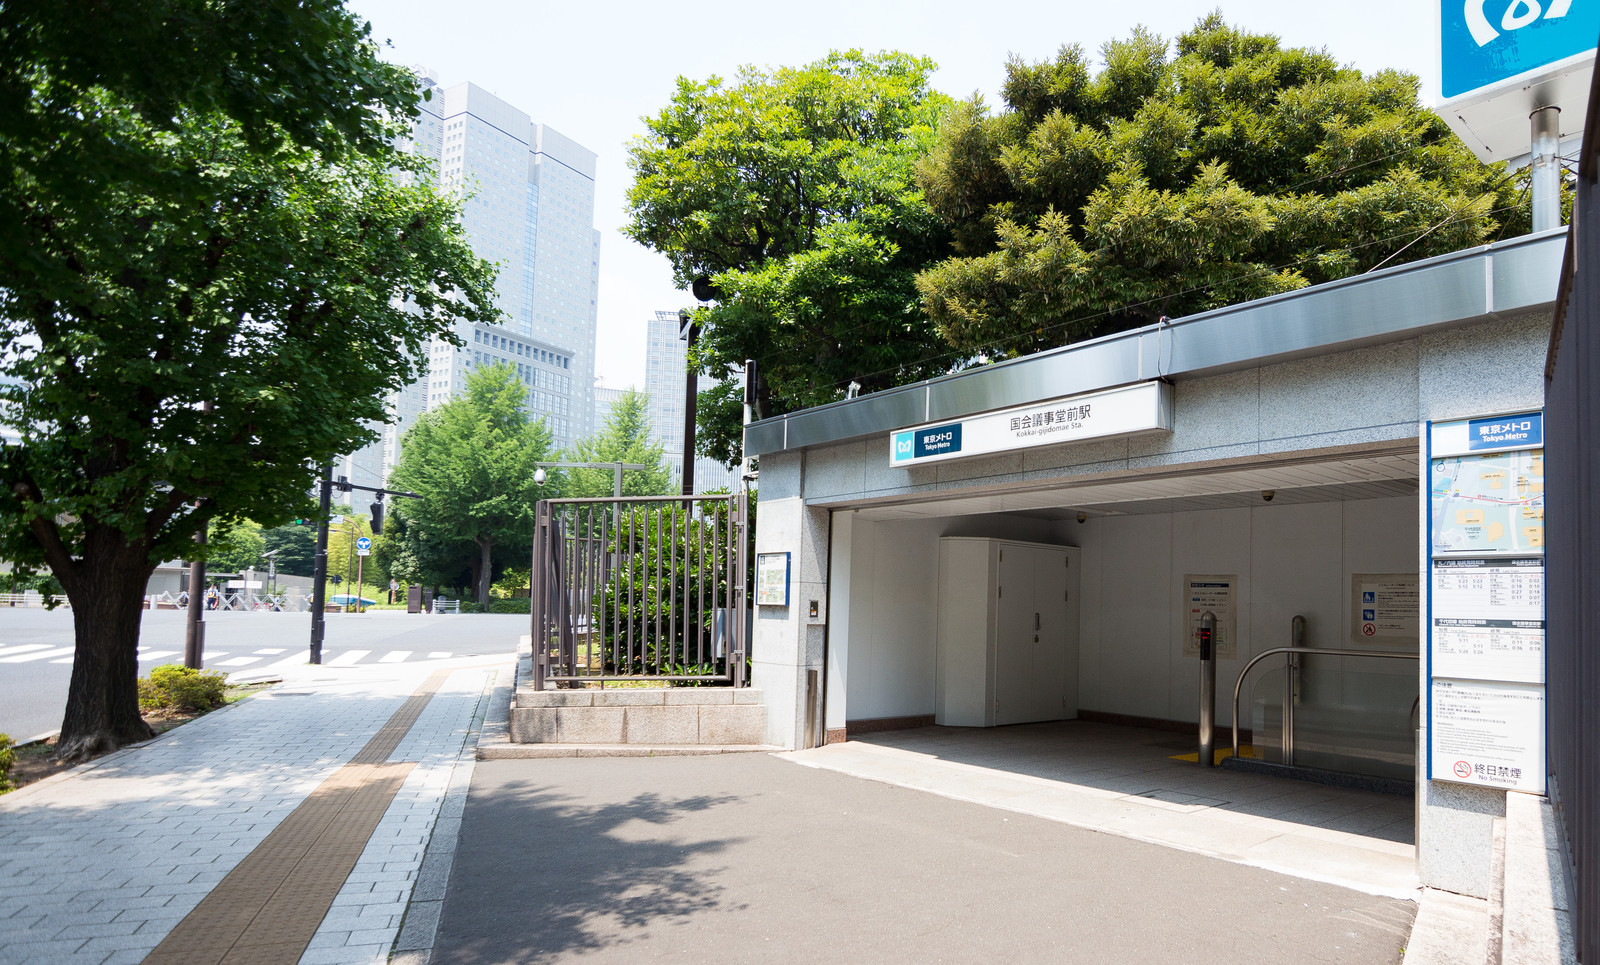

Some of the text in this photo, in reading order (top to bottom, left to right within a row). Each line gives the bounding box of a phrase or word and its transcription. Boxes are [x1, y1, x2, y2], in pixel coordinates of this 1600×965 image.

[1011, 404, 1091, 431] 国会議事堂前駅
[1016, 422, 1083, 438] Kokkai-gijidomae Sta.
[1479, 421, 1531, 435] 東京メトロ
[923, 432, 952, 444] 東京メトロ
[1483, 432, 1528, 443] Tokyo Metro
[1474, 763, 1522, 779] 終日禁煙
[1489, 776, 1518, 785] Smoking
